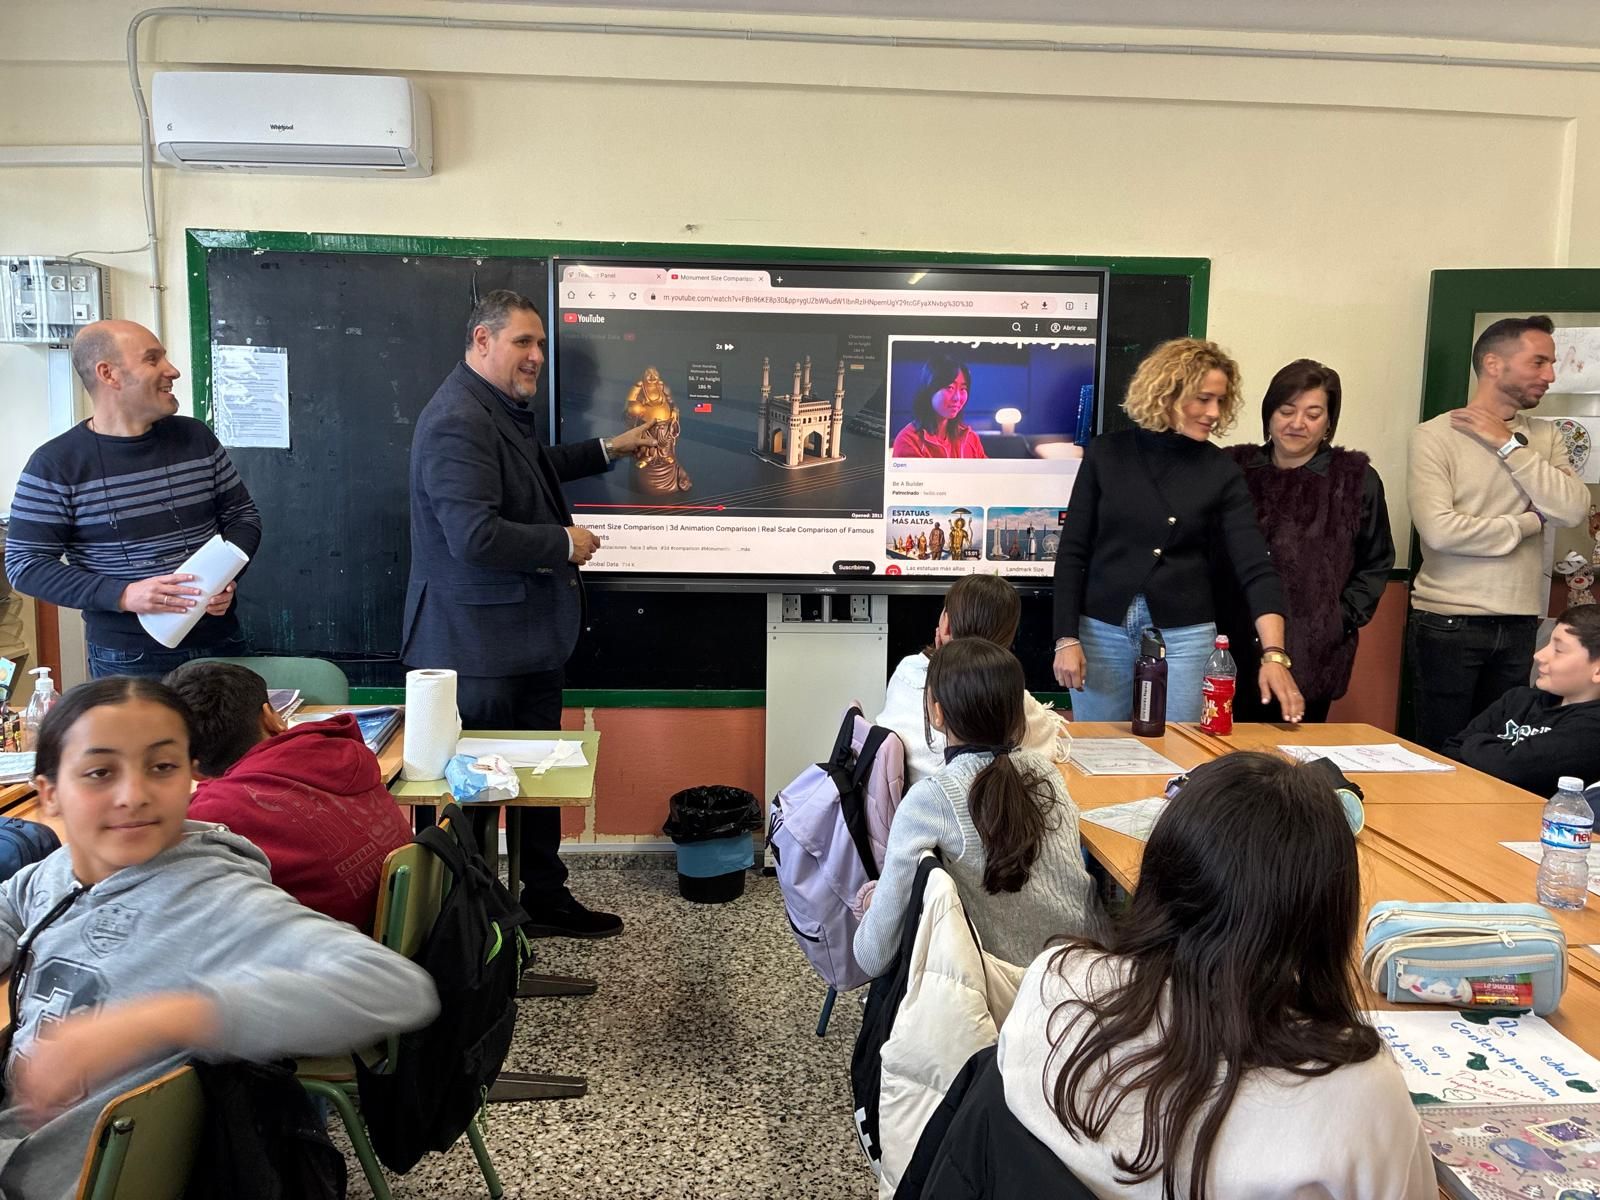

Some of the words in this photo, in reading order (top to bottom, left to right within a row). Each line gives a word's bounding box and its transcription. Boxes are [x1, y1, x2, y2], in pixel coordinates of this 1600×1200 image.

[578, 314, 605, 323] YouTube
[1432, 1045, 1451, 1060] en
[1540, 1055, 1579, 1077] edad
